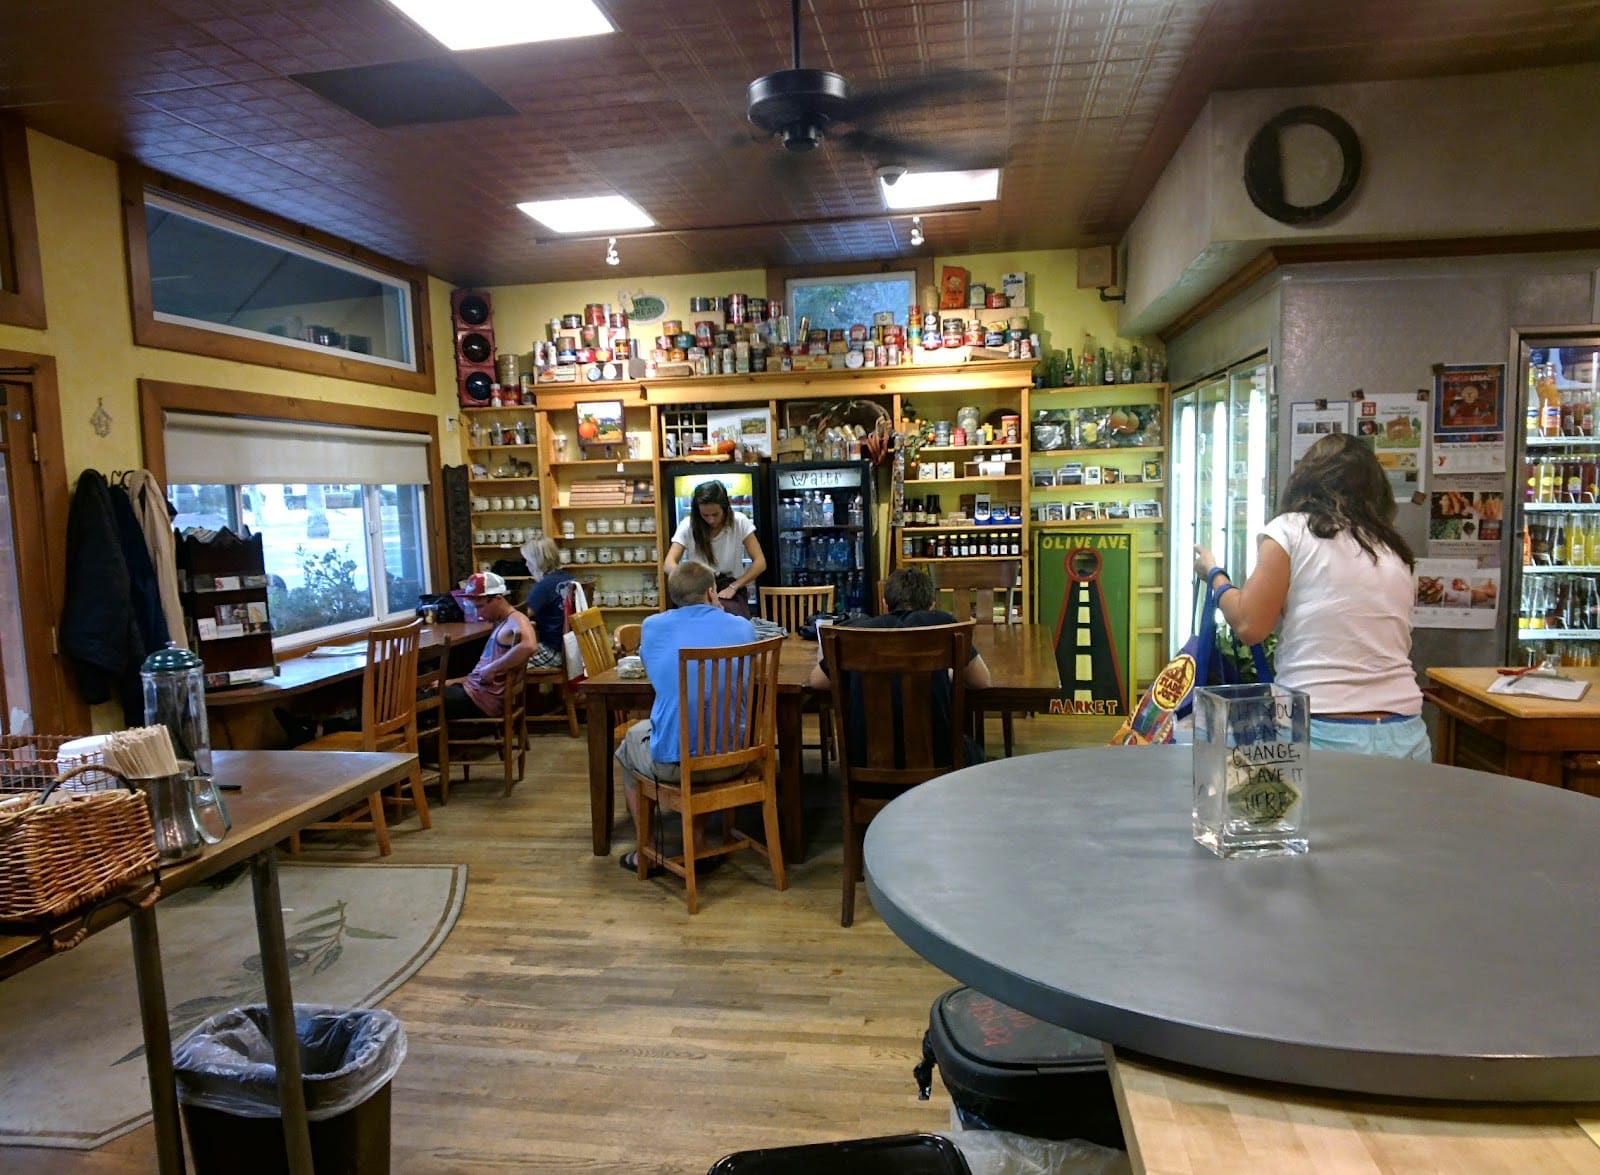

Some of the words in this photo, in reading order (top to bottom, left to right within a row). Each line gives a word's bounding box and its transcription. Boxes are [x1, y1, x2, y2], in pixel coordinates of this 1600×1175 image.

[1042, 536, 1092, 549] OLIVE
[1049, 698, 1118, 715] MARKET
[1235, 767, 1284, 786] LEAVE
[1291, 769, 1304, 783] IT
[1243, 791, 1287, 812] HERE
